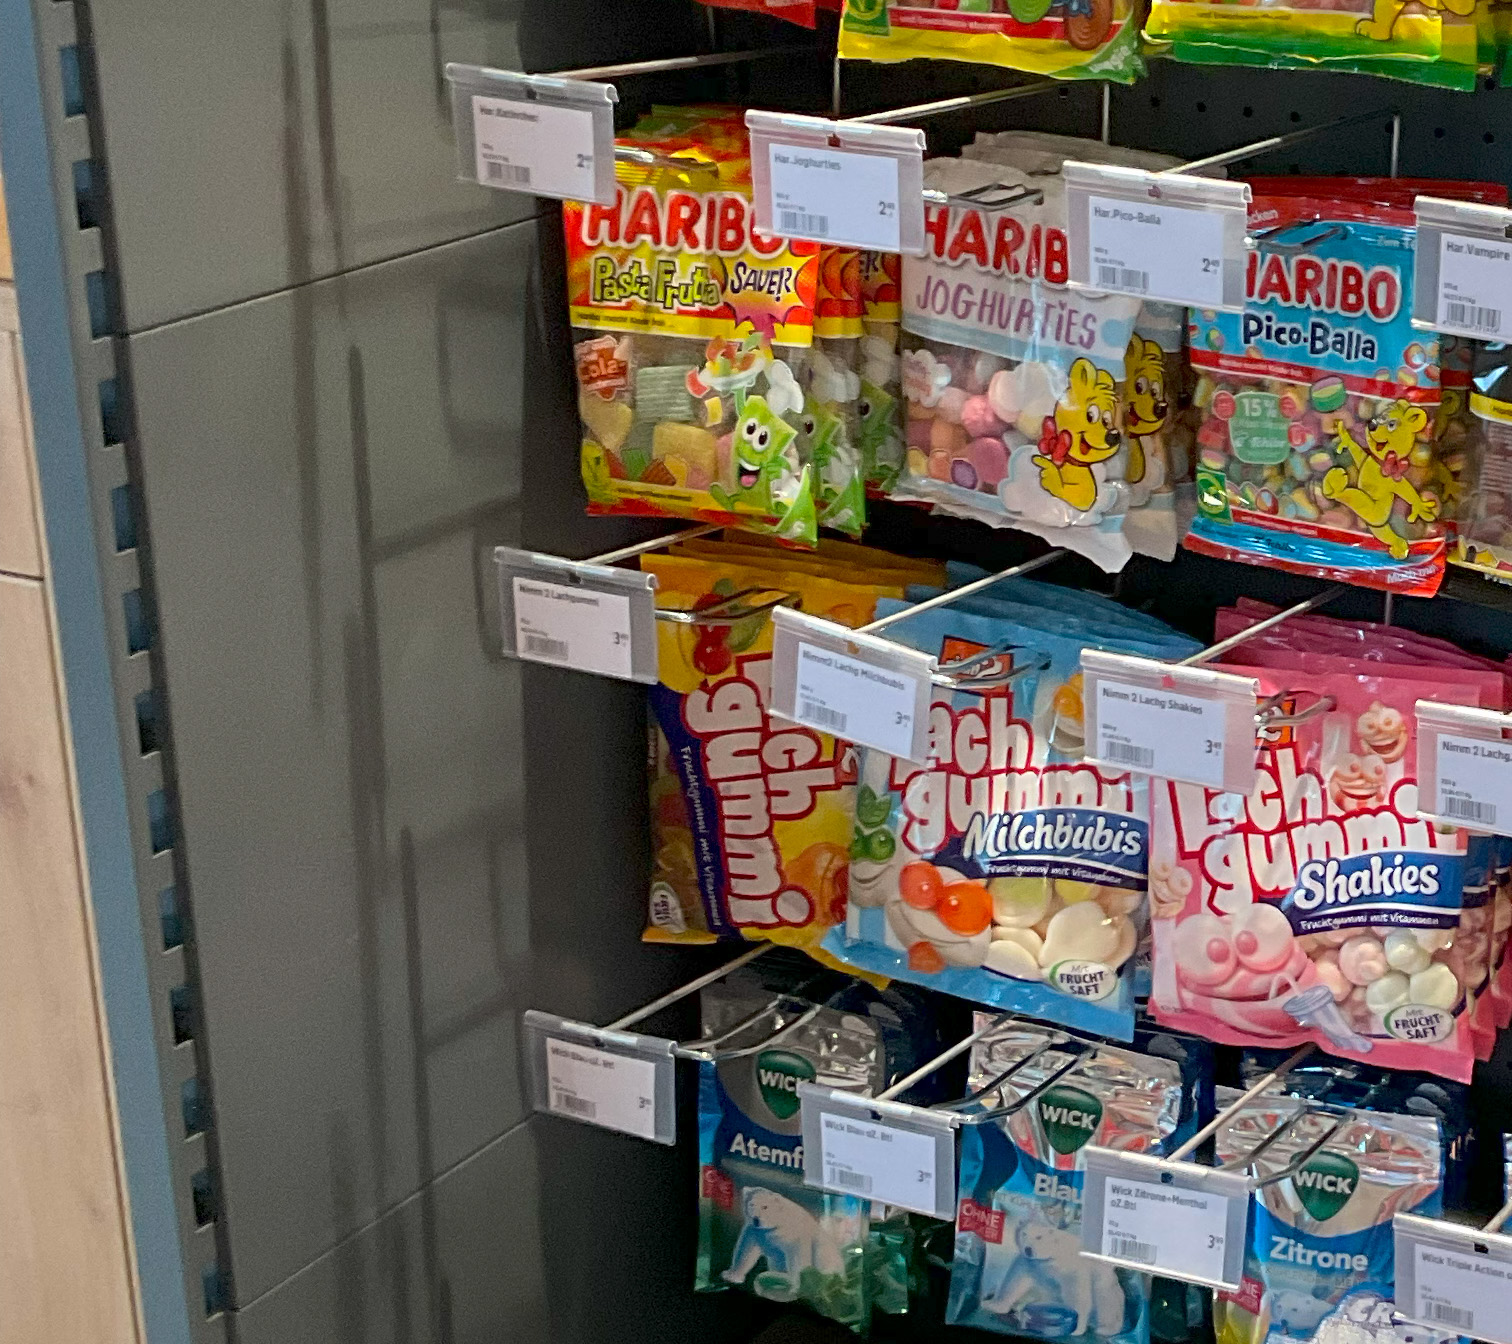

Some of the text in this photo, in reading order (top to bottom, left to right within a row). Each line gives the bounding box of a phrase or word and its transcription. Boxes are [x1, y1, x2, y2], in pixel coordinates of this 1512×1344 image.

[1093, 205, 1162, 226] Har.Pico-Balla
[1445, 240, 1511, 262] Har.Vampire
[592, 257, 723, 311] Pasta Frutta
[1241, 316, 1378, 364] Pico-Balla
[1102, 687, 1129, 700] Nimm
[1441, 740, 1470, 755] Nimm
[962, 812, 1142, 860] Milchbubis
[1296, 857, 1441, 910] Shakies
[1300, 915, 1369, 933] Fruchtgummi
[1069, 981, 1101, 995] SAFT
[1405, 1025, 1440, 1042] SAFT
[1040, 1106, 1095, 1130] WICK
[1111, 1184, 1134, 1198] Wick
[1298, 1169, 1354, 1196] WICK
[961, 1203, 1000, 1228] OHNE
[1269, 1235, 1369, 1271] Zitrone
